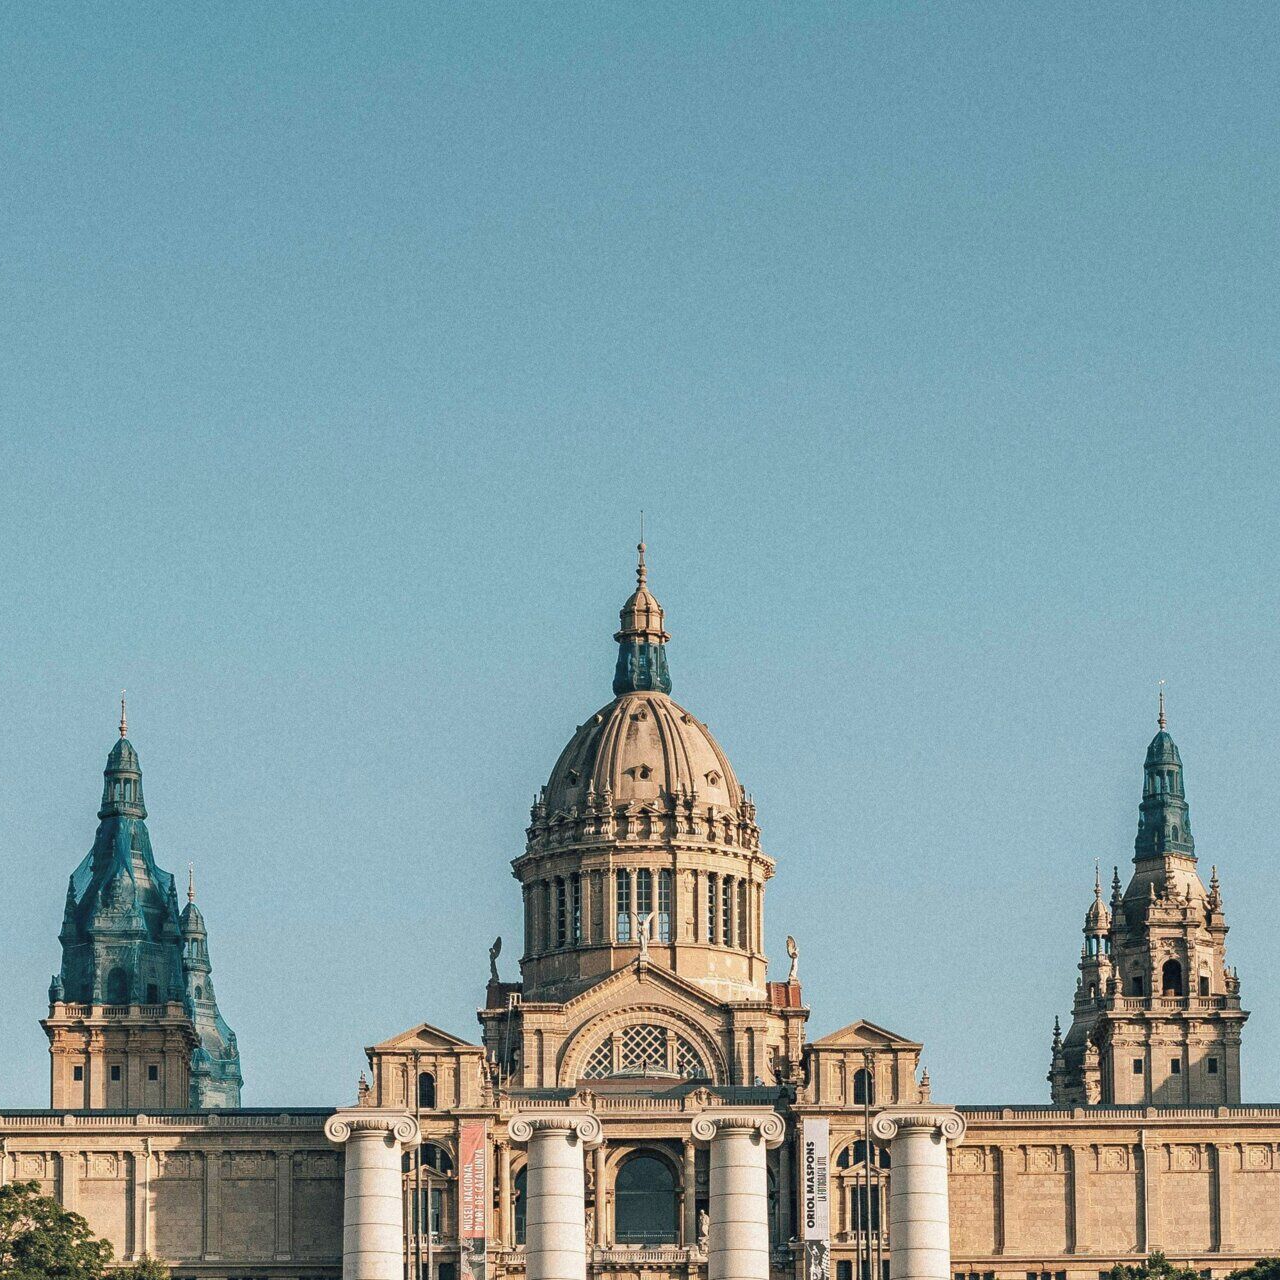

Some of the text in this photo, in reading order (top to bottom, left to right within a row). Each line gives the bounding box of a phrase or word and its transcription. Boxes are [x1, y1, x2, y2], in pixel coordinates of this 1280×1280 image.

[463, 1163, 473, 1231] MUSEU NACIONAL
[475, 1148, 484, 1193] CATALUNYA
[806, 1141, 815, 1228] ORIOL MASPONS
[475, 1195, 484, 1205] DE
